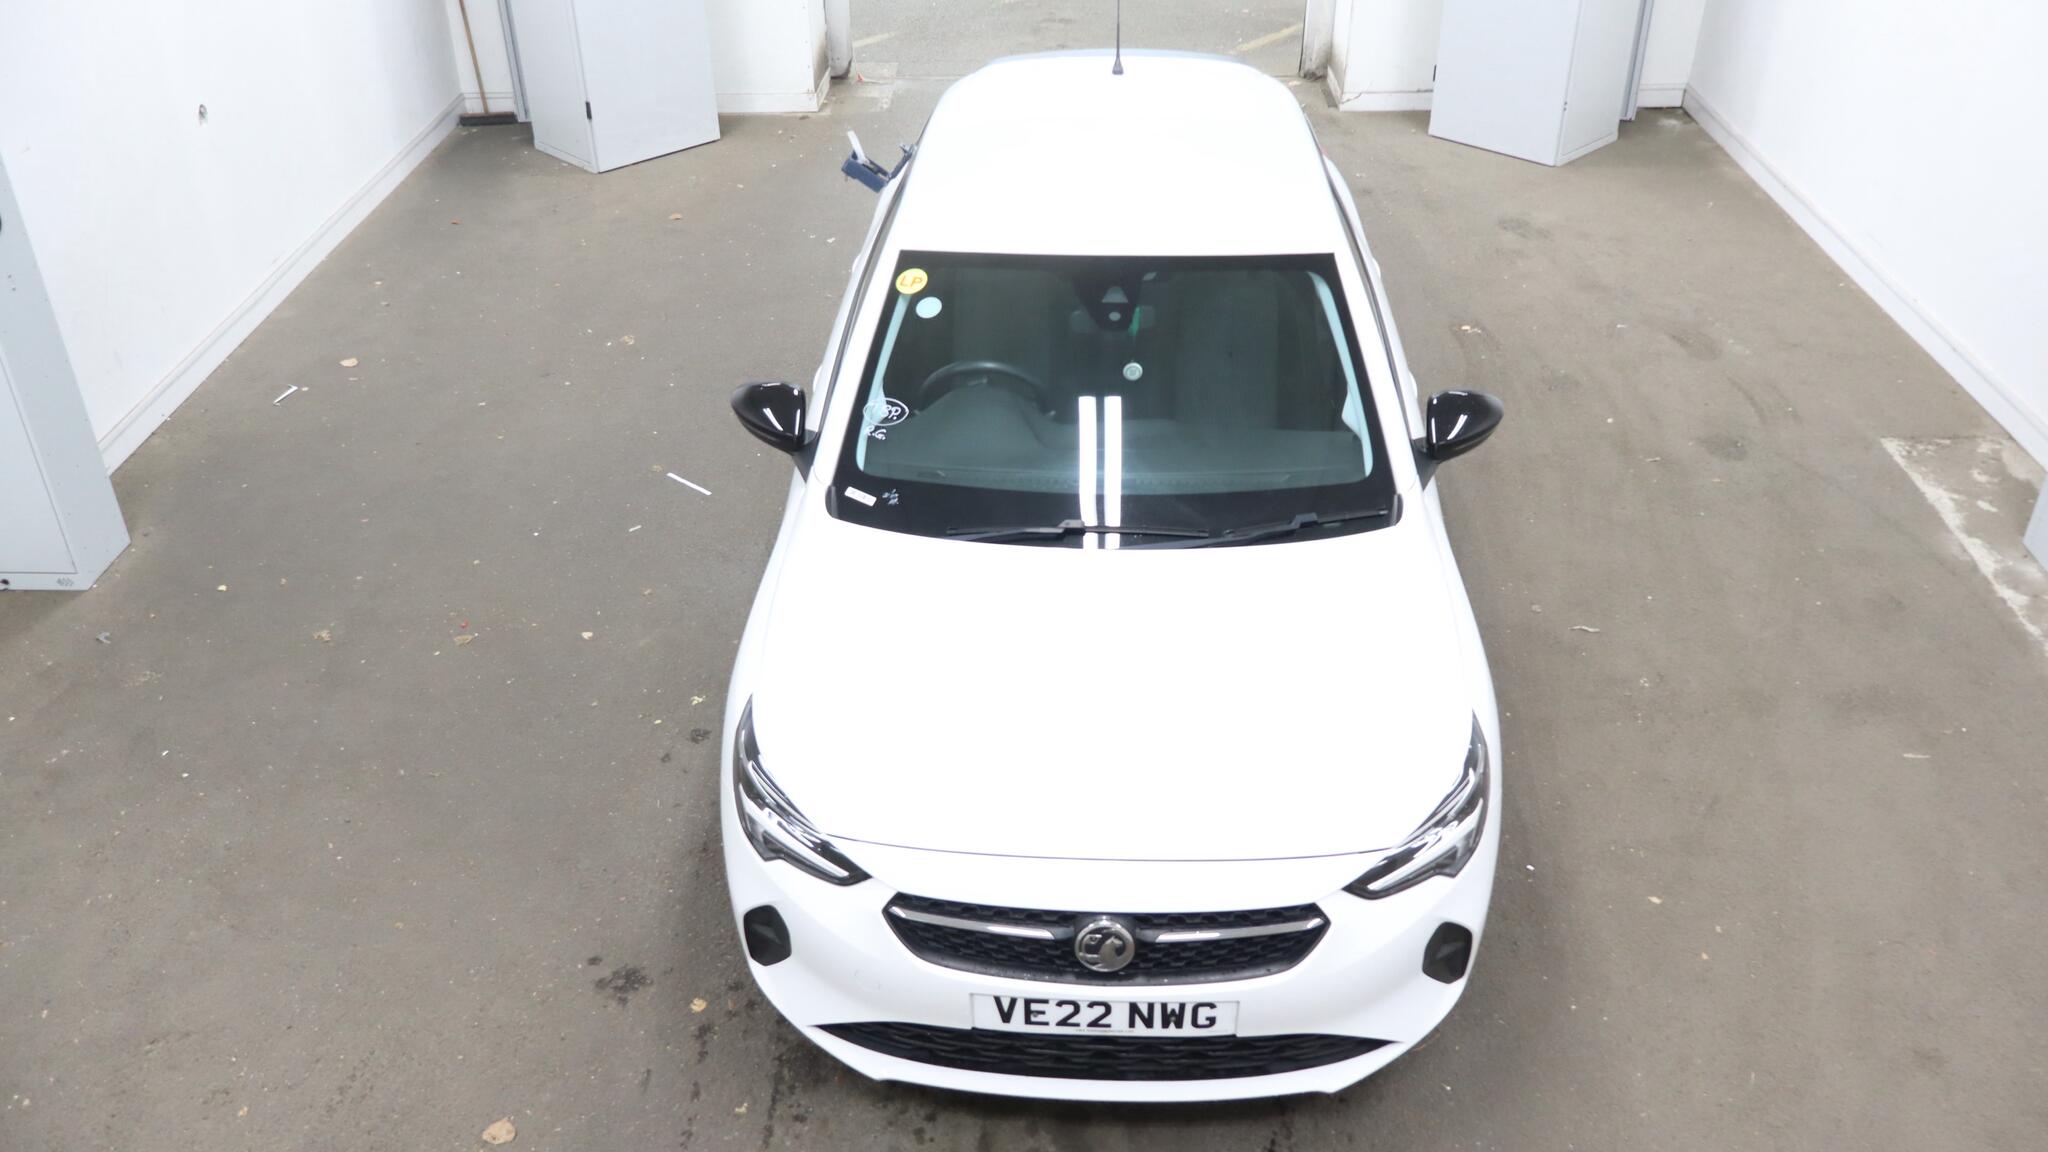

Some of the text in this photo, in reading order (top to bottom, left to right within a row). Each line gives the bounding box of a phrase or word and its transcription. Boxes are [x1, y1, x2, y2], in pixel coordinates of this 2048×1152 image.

[900, 275, 923, 287] LP
[993, 995, 1218, 1029] VE22 NWG
